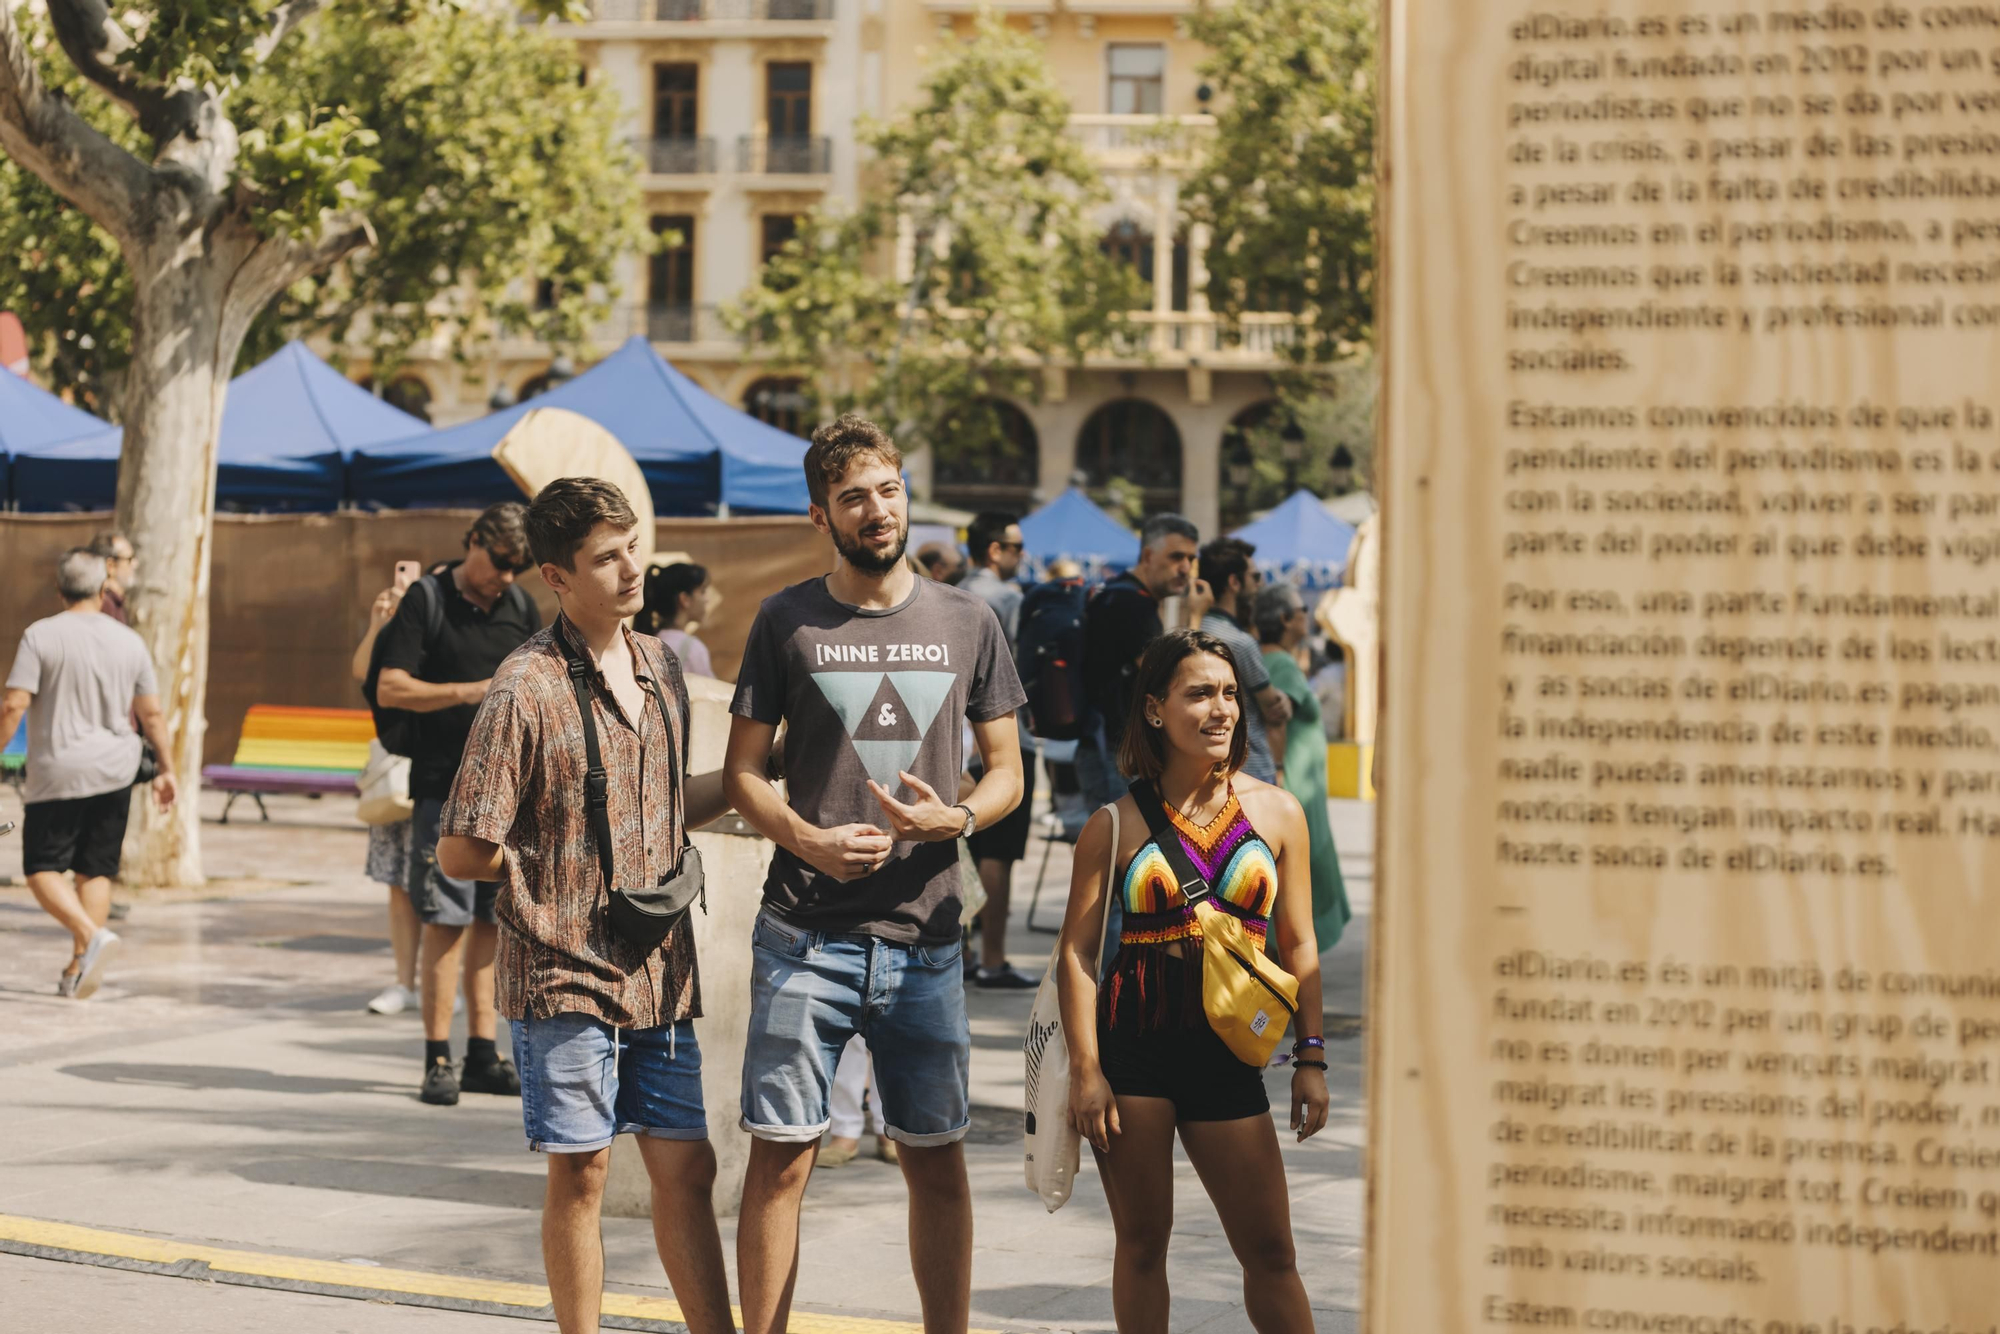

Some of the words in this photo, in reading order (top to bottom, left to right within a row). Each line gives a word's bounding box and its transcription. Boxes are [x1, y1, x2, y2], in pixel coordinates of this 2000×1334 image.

[1510, 11, 1670, 40] elDiario.es
[1680, 14, 1708, 37] es
[1719, 12, 1760, 35] un
[1766, 6, 1865, 32] medio
[1872, 2, 1911, 32] de
[1510, 55, 1602, 86] digital
[1614, 49, 1744, 78] fundado
[1753, 53, 1791, 76] en
[1799, 45, 1868, 74] 2012
[1878, 48, 1929, 79] por
[1940, 47, 1982, 71] un
[1508, 95, 1677, 129] periodistas
[1685, 95, 1745, 124] que
[1751, 95, 1793, 118] no
[1804, 93, 1834, 115] se
[1845, 84, 1882, 114] da
[1892, 91, 1942, 121] por
[1508, 132, 1547, 163] de
[1553, 132, 1580, 162] la
[1683, 138, 1701, 160] a
[1708, 136, 1793, 166] pesar
[1806, 127, 1842, 159] de
[1850, 129, 1894, 158] las
[1508, 183, 1525, 204] a
[1533, 183, 1615, 211] pesar
[1624, 174, 1665, 202] de
[1672, 173, 1699, 202] la
[1708, 169, 1779, 201] falta
[1787, 173, 1826, 200] de
[1506, 219, 1638, 246] Creemos
[1650, 221, 1688, 245] en
[1696, 213, 1724, 244] el
[1924, 217, 1942, 240] a
[1506, 260, 1638, 288] Creemos
[1649, 265, 1705, 292] que
[1715, 256, 1741, 286] la
[1752, 254, 1888, 286] sociedad
[1508, 299, 1729, 335] independiente
[1736, 308, 1754, 334] y
[1764, 296, 1943, 333] profesional
[1508, 400, 1636, 431] Estamos
[1647, 396, 1840, 432] convencidos
[1848, 397, 1887, 430] de
[1896, 404, 1956, 437] que
[1964, 397, 1992, 430] la
[1506, 440, 1661, 477] pendiente
[1669, 440, 1716, 473] del
[1725, 437, 1900, 477] periodismo
[1911, 446, 1943, 473] es
[1953, 439, 1980, 473] la
[1506, 486, 1560, 514] con
[1567, 482, 1595, 514] la
[1757, 482, 1852, 516] volver
[1864, 492, 1882, 515] a
[1892, 490, 1937, 516] ser
[1505, 525, 1586, 559] parte
[1599, 523, 1642, 555] del
[1650, 524, 1738, 563] poder
[1751, 524, 1777, 558] al
[1786, 530, 1844, 564] que
[1853, 524, 1930, 560] debe
[1502, 581, 1555, 612] Por
[1635, 589, 1693, 616] una
[1701, 588, 1788, 620] parte
[1501, 623, 1687, 660] financiación
[1697, 626, 1830, 665] depende
[1840, 628, 1877, 662] de
[1887, 629, 1932, 664] los
[1499, 674, 1519, 701] y
[1535, 672, 1567, 700] as
[1578, 666, 1672, 701] socias
[1681, 668, 1716, 701] de
[1729, 670, 1891, 703] elDiario.es
[1500, 710, 1526, 742] la
[1535, 707, 1761, 750] independencia
[1770, 711, 1807, 748] de
[1815, 718, 1882, 750] este
[1498, 750, 1584, 785] nadie
[1590, 752, 1687, 789] pueda
[1697, 761, 1906, 793] amenazarnos
[1915, 765, 1934, 798] y
[1497, 793, 1616, 827] noticias
[1624, 800, 1736, 834] tengan
[1742, 796, 1872, 838] impacto
[1497, 833, 1584, 868] hazte
[1592, 838, 1669, 871] socia
[1679, 838, 1716, 872] de
[1494, 949, 1649, 987] elDiario.es
[1660, 955, 1692, 988] és
[1703, 961, 1740, 989] un
[1746, 963, 1824, 997] mitjà
[1833, 961, 1872, 996] de
[1495, 988, 1593, 1025] fundat
[1604, 1000, 1640, 1028] en
[1647, 998, 1716, 1028] 2012
[1724, 1004, 1773, 1037] per
[1785, 1008, 1822, 1036] un
[1829, 1010, 1903, 1043] grup
[1913, 1008, 1949, 1041] de
[1491, 1037, 1533, 1064] no
[1539, 1040, 1570, 1066] es
[1580, 1037, 1676, 1071] donen
[1683, 1045, 1733, 1075] per
[1742, 1049, 1861, 1080] vençuts
[1872, 1051, 1990, 1089] malgrat
[1492, 1073, 1608, 1110] malgrat
[1618, 1079, 1657, 1113] les
[1665, 1083, 1807, 1120] pressions
[1818, 1085, 1865, 1123] del
[1490, 1118, 1530, 1144] de
[1533, 1119, 1693, 1155] credibilitat
[1703, 1127, 1740, 1159] de
[1748, 1128, 1775, 1160] la
[1670, 1165, 1788, 1206] malgrat
[1861, 1176, 1968, 1212] Creiem
[1488, 1202, 1625, 1234] necessita
[1634, 1204, 1796, 1245] informació
[1488, 1243, 1553, 1269] amb
[1560, 1247, 1650, 1276] valors
[1482, 1294, 1578, 1328] Estem
